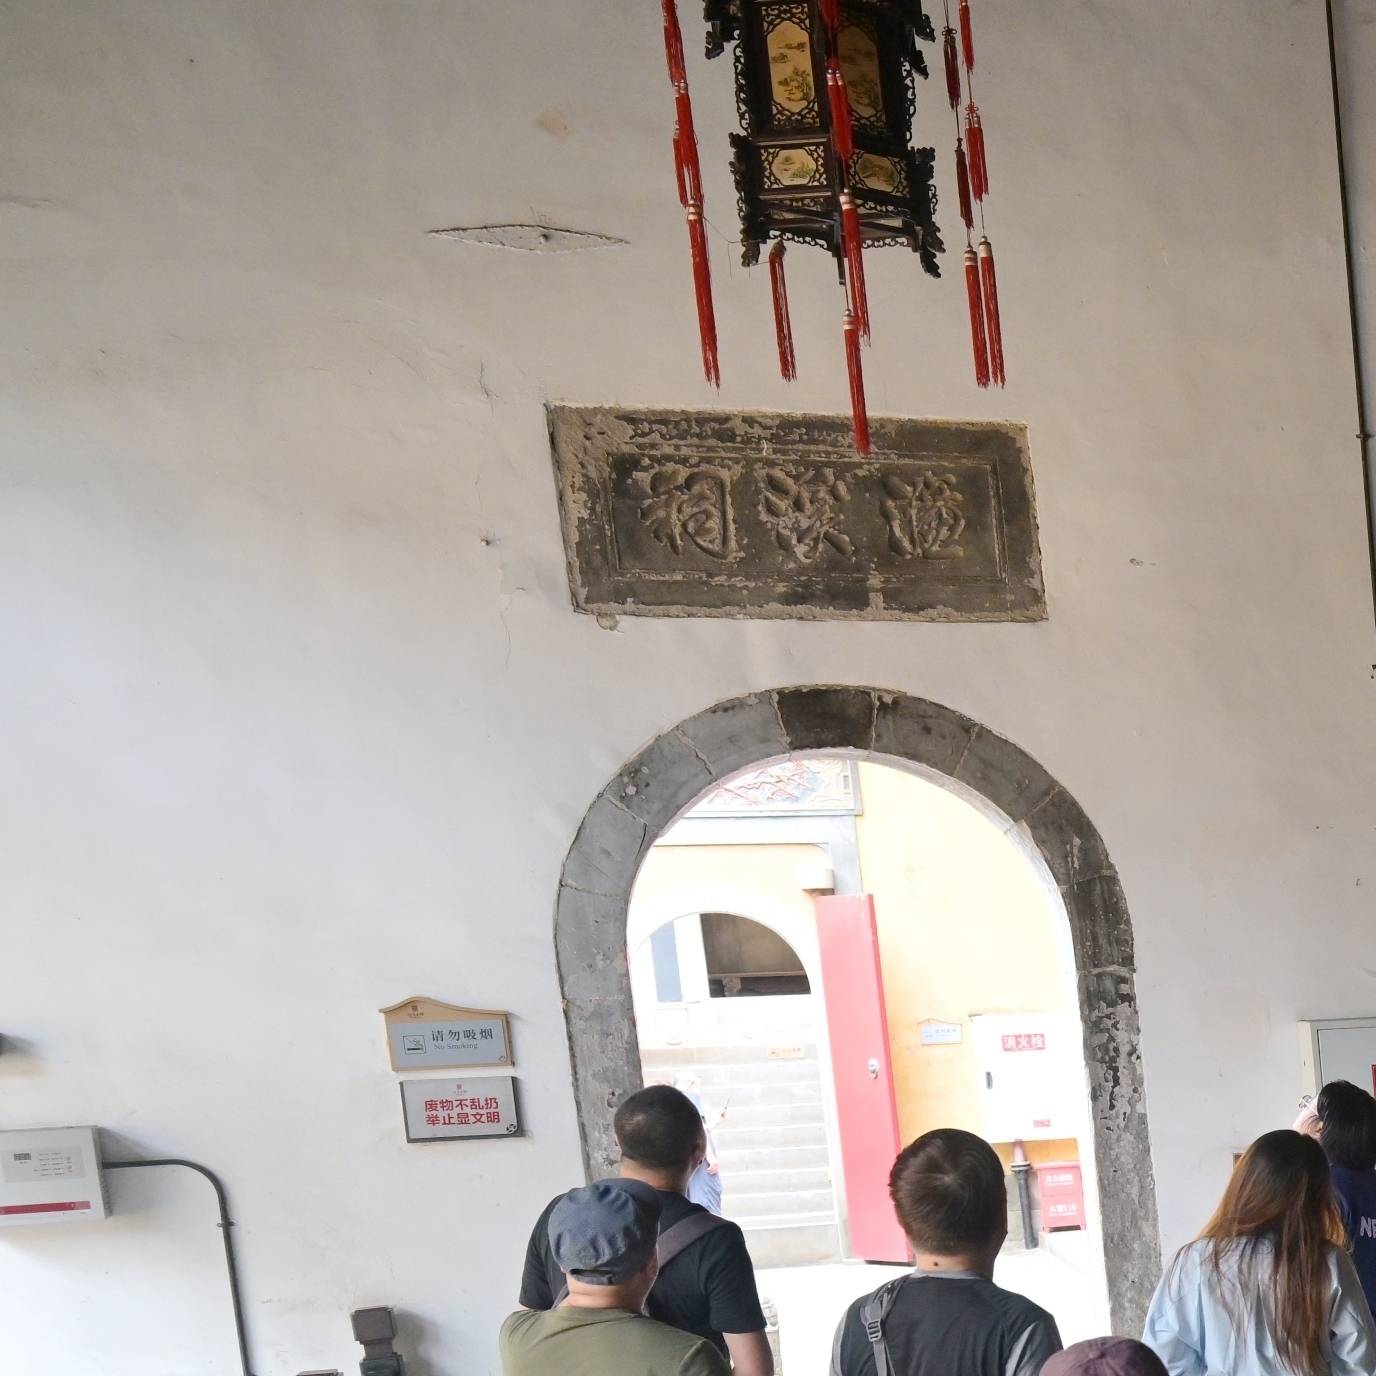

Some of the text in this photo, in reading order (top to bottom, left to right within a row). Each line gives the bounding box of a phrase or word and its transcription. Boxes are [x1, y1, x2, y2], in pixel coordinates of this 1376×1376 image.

[431, 1028, 494, 1042] 请勿吸烟
[1004, 1036, 1045, 1048] 消火栓
[447, 1043, 478, 1051] Smoking
[425, 1098, 499, 1112] 废物不乱扔
[425, 1112, 501, 1126] 举止显文明
